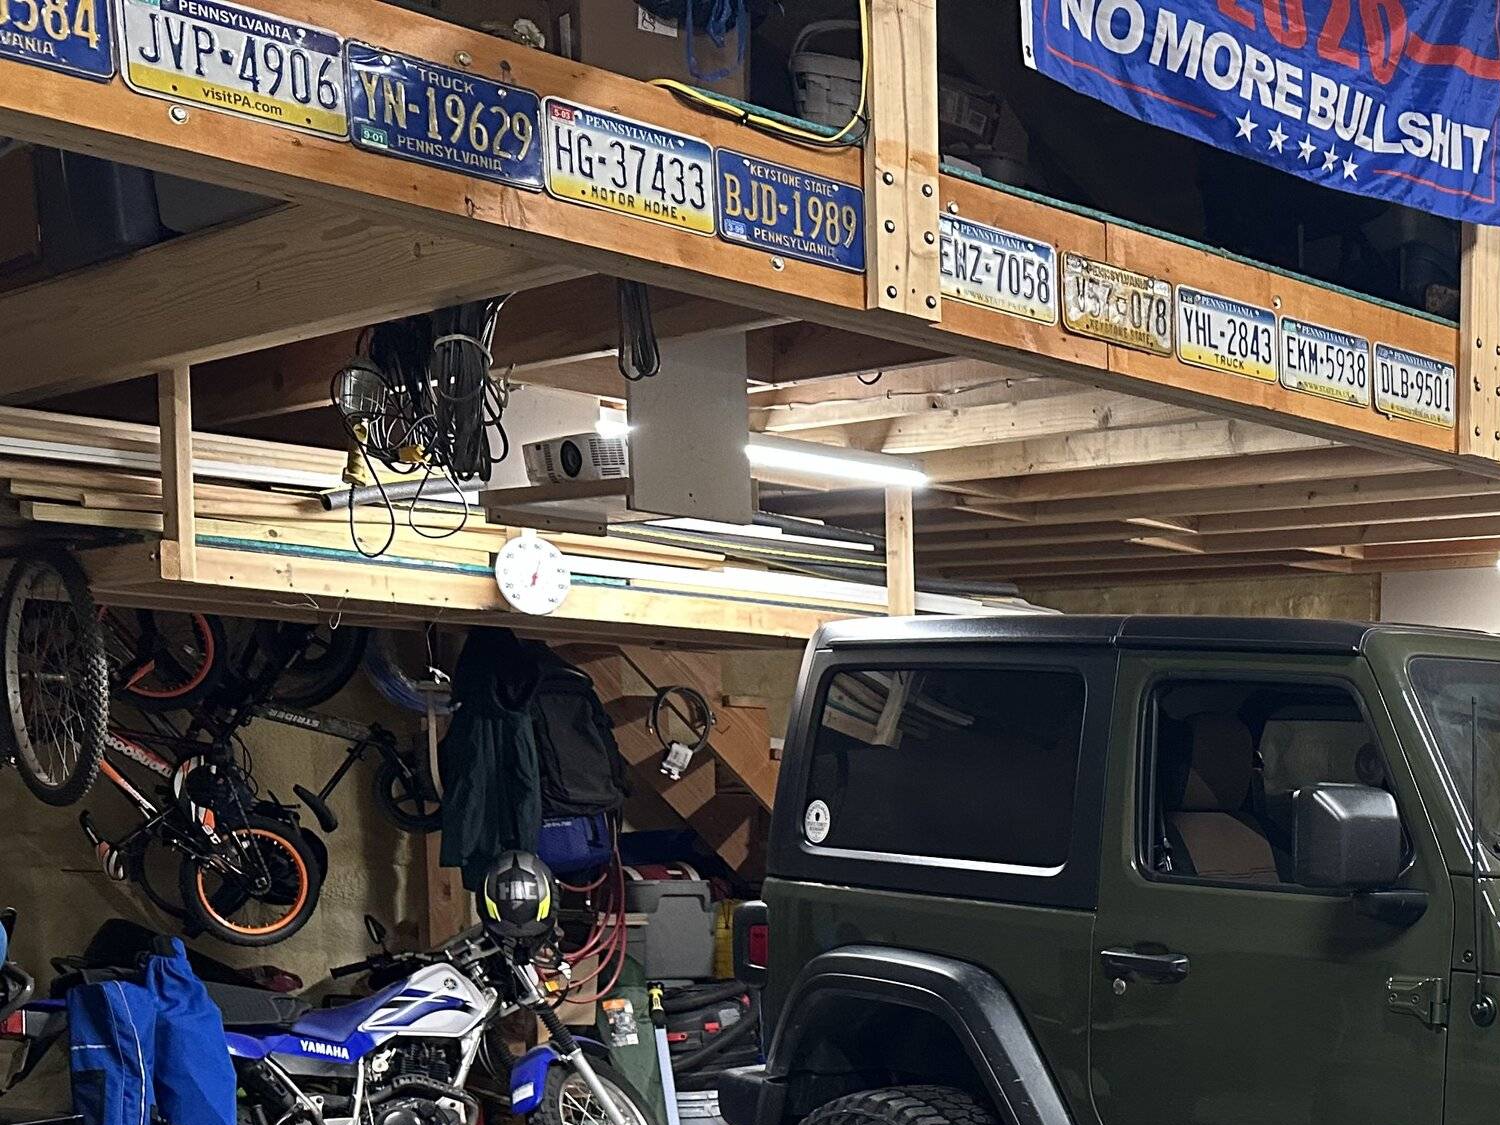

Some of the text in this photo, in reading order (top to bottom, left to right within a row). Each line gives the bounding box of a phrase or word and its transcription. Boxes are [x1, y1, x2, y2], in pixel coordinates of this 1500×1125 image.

[179, 0, 292, 40] PENNSYLVANIA
[139, 14, 339, 110] JVP-4906
[417, 68, 475, 95] TRUCK
[1060, 0, 1490, 174] NO MORE BULLSHIT
[202, 87, 283, 115] visitPA.com
[358, 70, 533, 162] YN-19629
[585, 114, 675, 150] PENNSYLVANIA
[397, 135, 503, 171] PENNSYLVANIA
[555, 125, 706, 210] HG-37433
[750, 164, 833, 197] KEYSTONE STATE
[591, 185, 678, 220] MOTOR HOME
[724, 173, 857, 248] BJD-1989
[754, 227, 836, 258] PENNSYLVANIA
[961, 224, 1026, 251] PENNSYLVANIA
[1201, 296, 1254, 318] PENNSYLVANIA
[1183, 307, 1272, 364] YHL-2843
[1302, 325, 1350, 347] PENNSYLVANIA
[1214, 353, 1245, 370] TRUCK
[300, 1039, 350, 1060] YAMAHA
